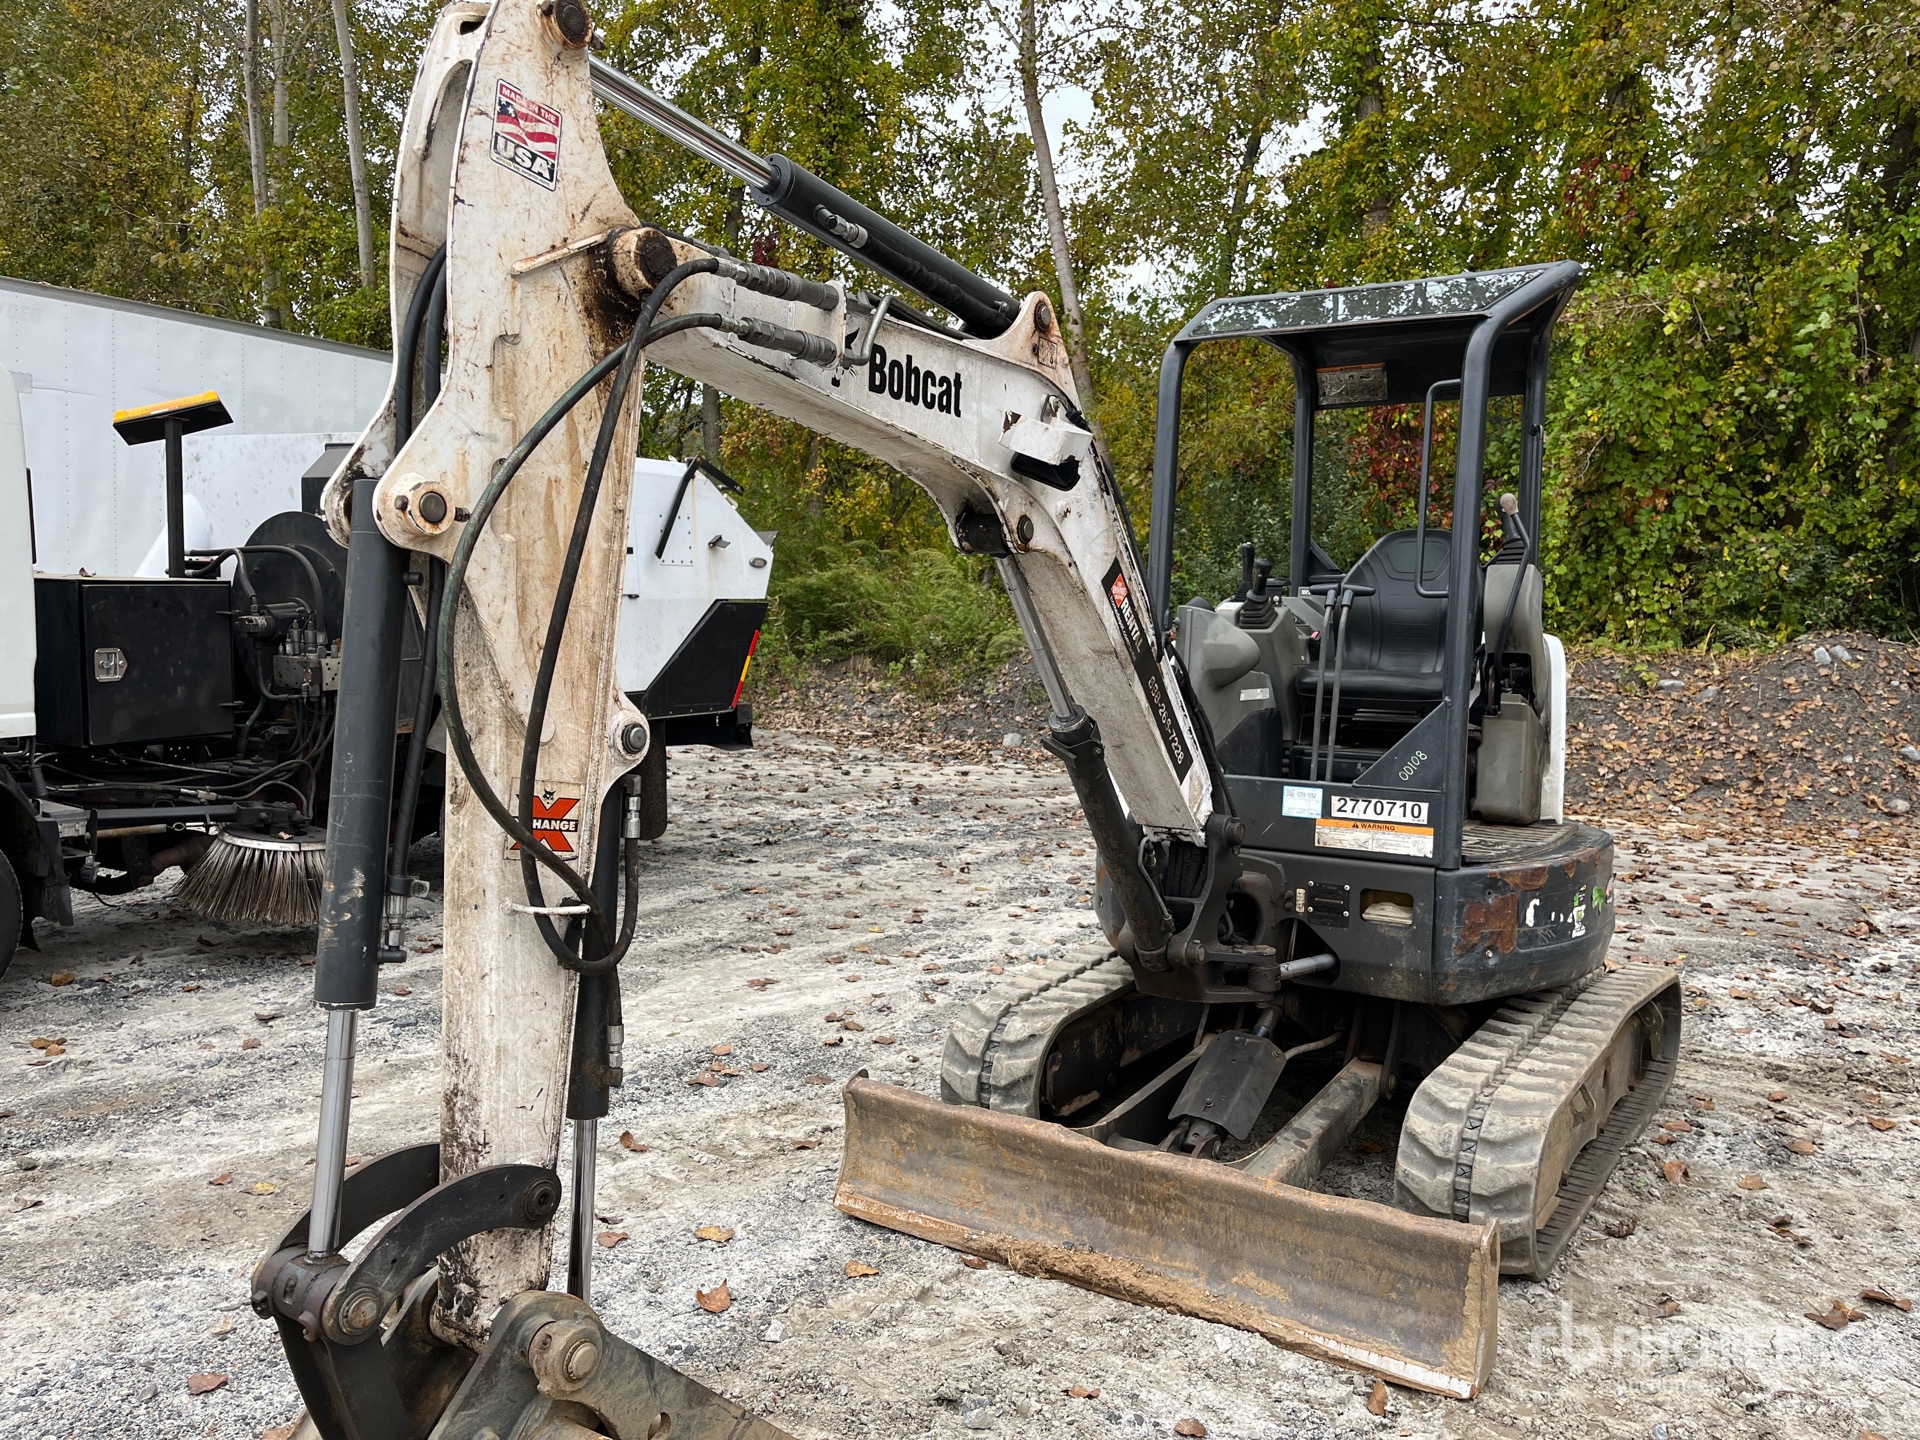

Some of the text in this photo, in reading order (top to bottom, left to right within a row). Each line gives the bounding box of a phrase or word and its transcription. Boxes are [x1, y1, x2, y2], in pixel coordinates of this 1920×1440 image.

[540, 107, 557, 123] THE
[497, 134, 551, 180] USA
[868, 343, 963, 418] Bobcat
[1398, 750, 1428, 781] 00108
[1336, 797, 1423, 819] 2770710
[1360, 822, 1396, 832] WARNING
